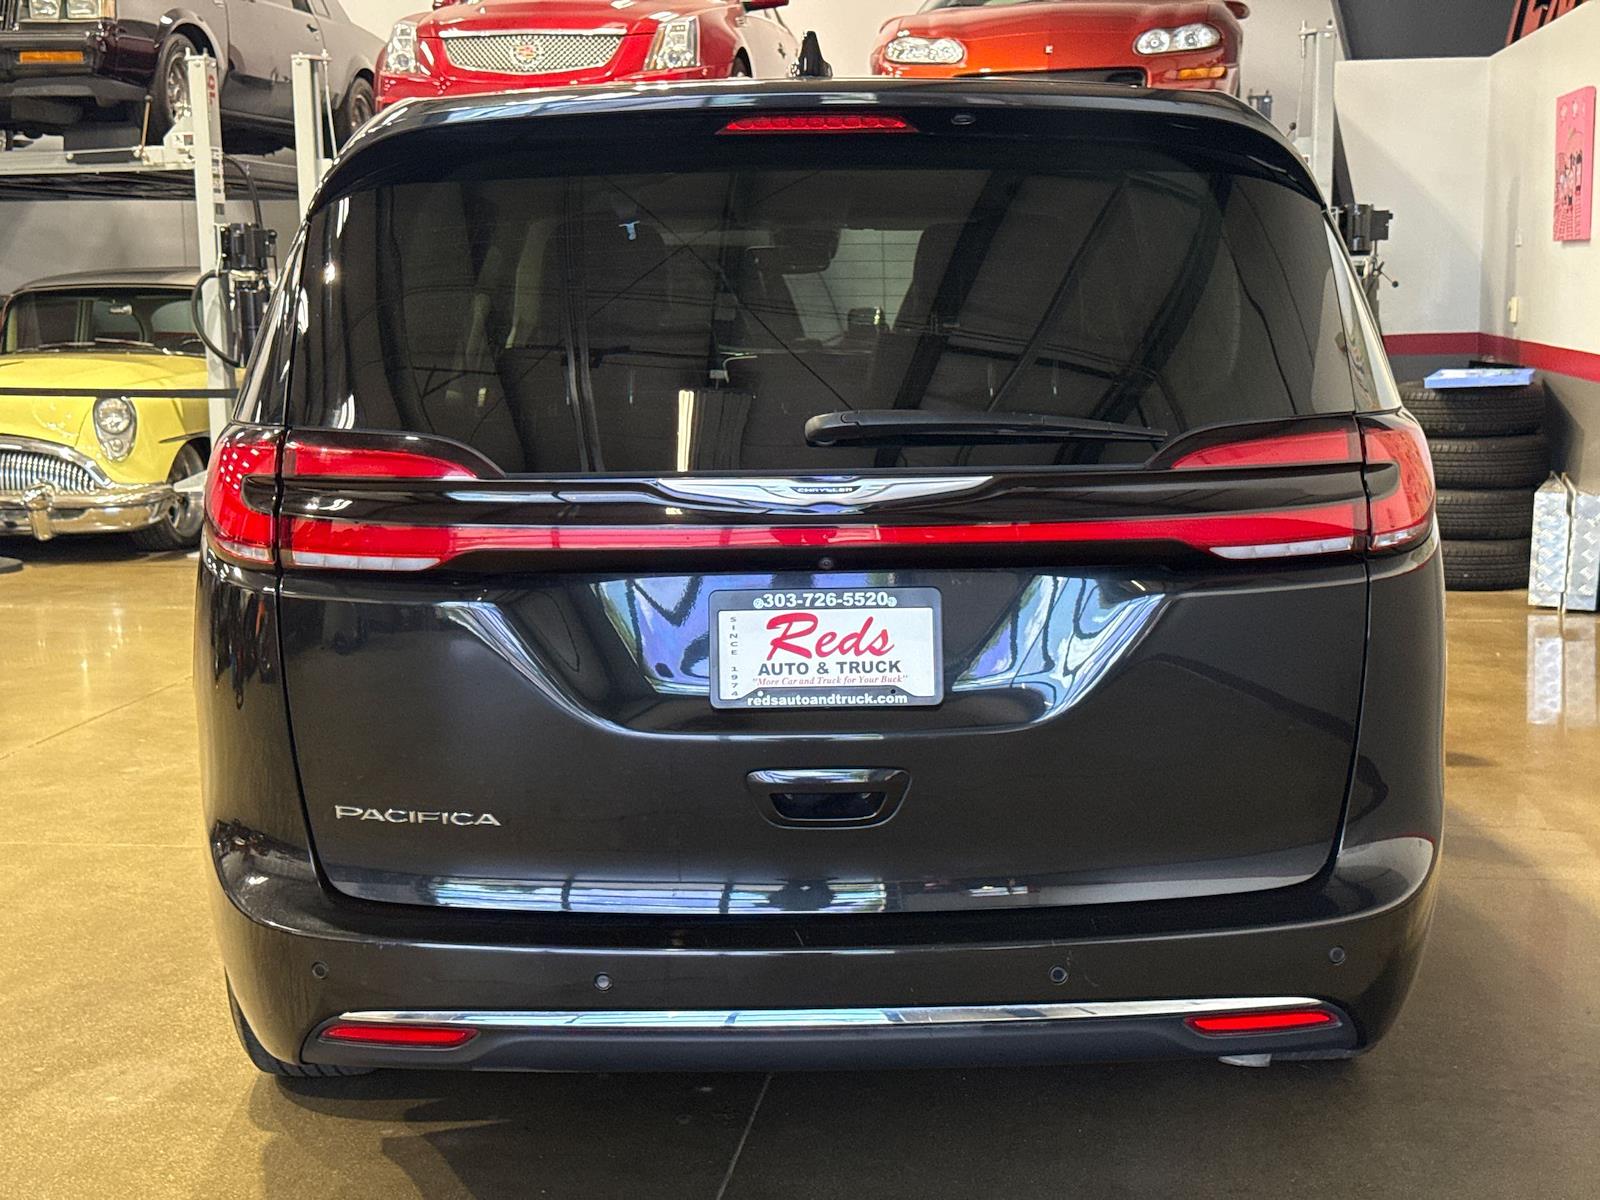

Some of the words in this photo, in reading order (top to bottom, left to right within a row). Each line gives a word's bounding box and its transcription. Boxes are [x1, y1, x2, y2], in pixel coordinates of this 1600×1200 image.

[762, 592, 888, 608] 303-726-5520
[729, 616, 739, 656] SINCE
[766, 612, 895, 661] Reds
[758, 662, 809, 676] AUTO
[816, 661, 830, 675] &
[836, 660, 902, 674] TRUCK
[730, 666, 739, 697] 1974
[782, 677, 798, 686] Car
[799, 677, 815, 685] and
[817, 676, 842, 685] Truck
[843, 675, 857, 685] for
[858, 675, 879, 684] Your
[747, 693, 908, 706] redsautoandtruck.com
[334, 804, 501, 827] PACIFICA
